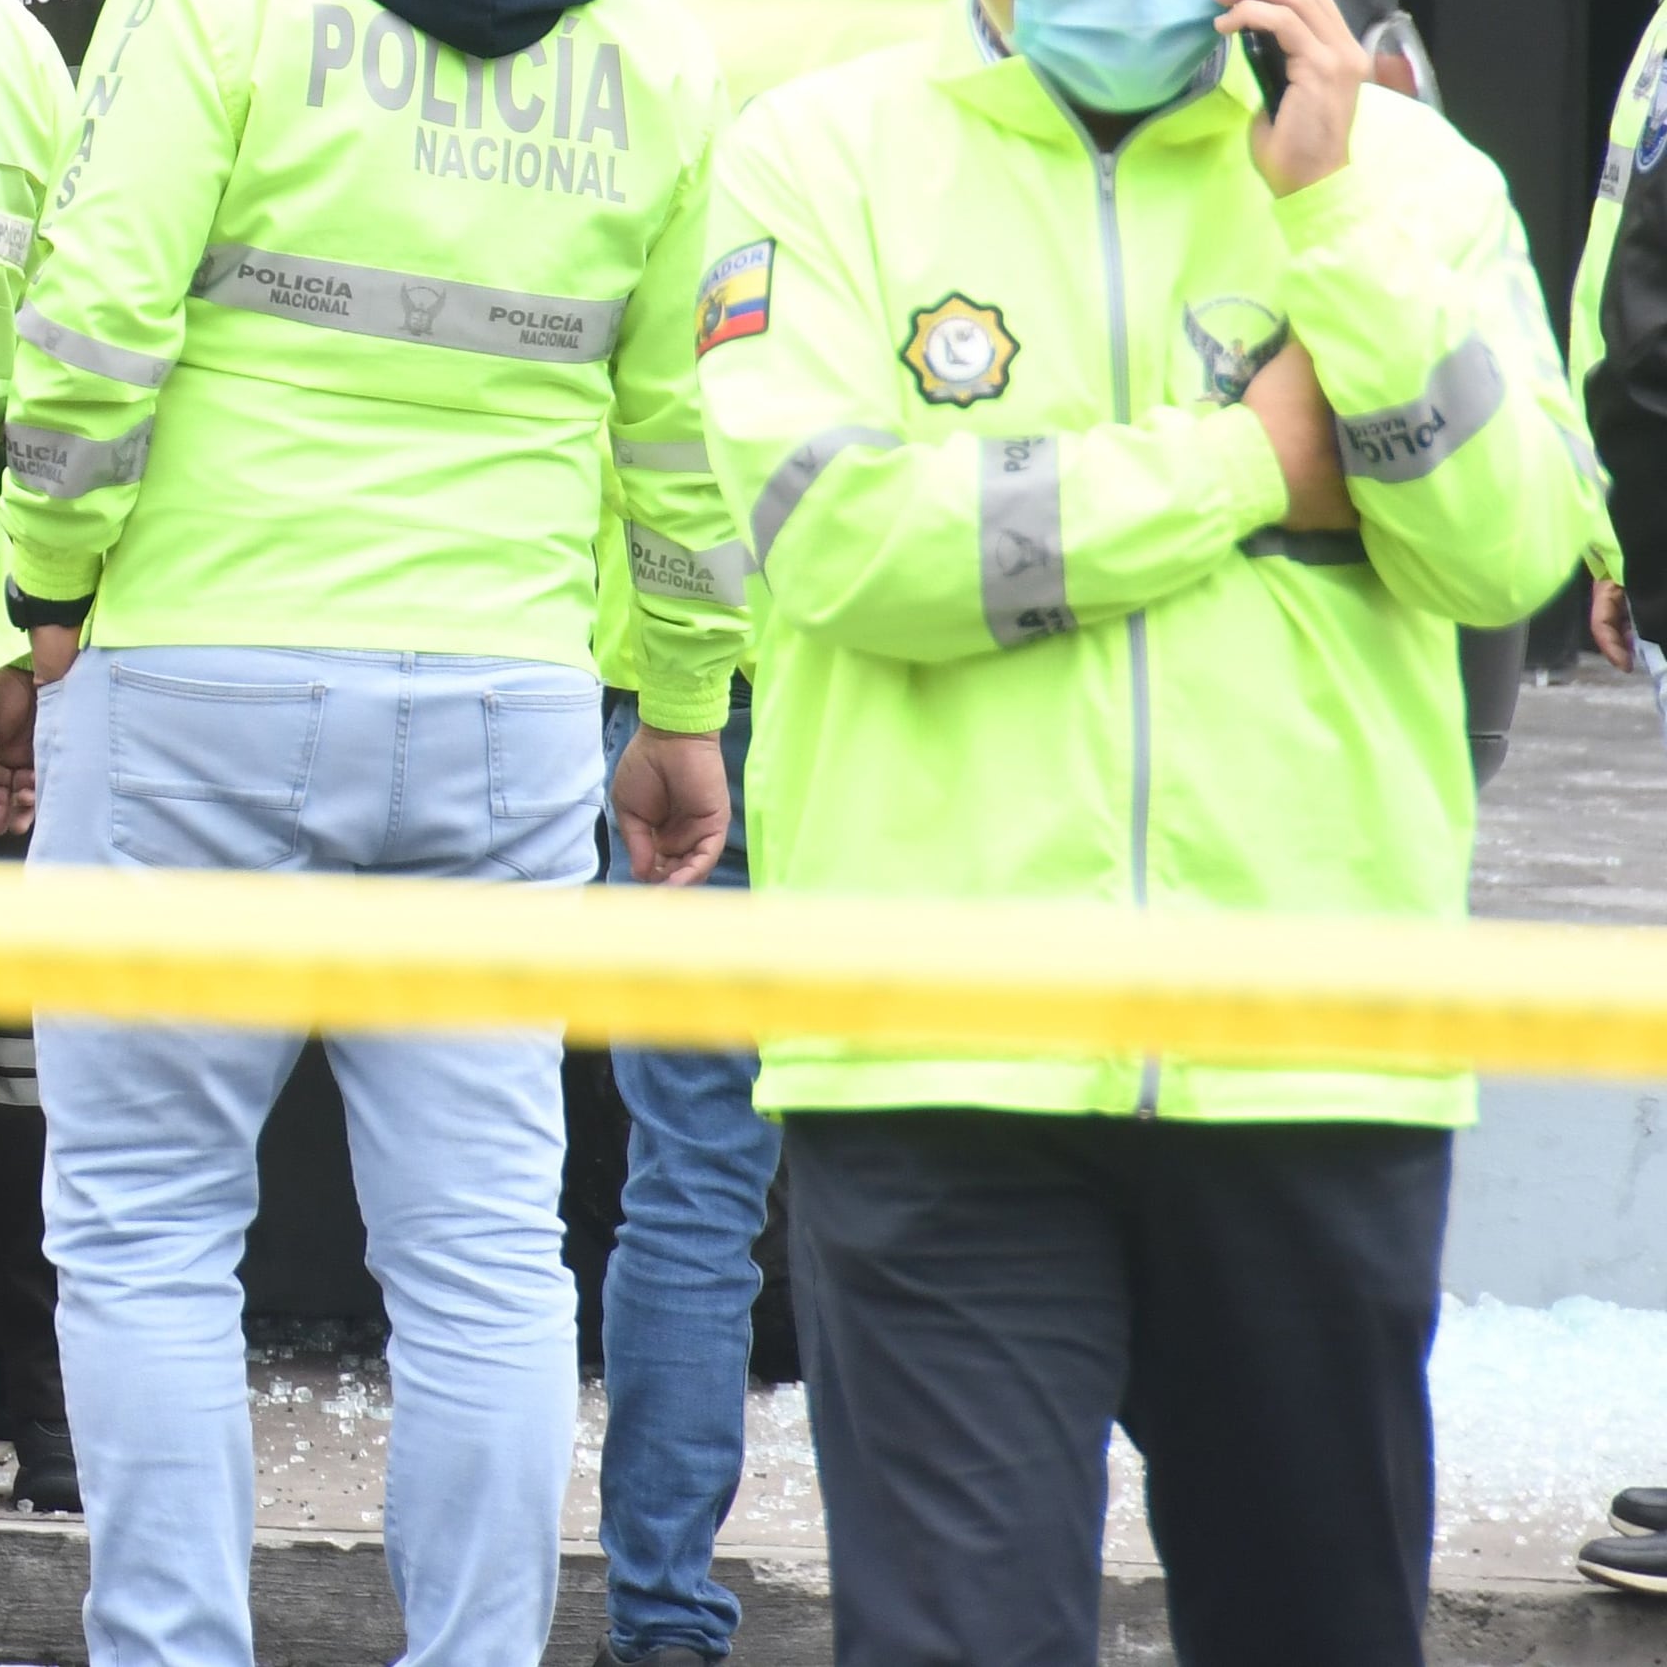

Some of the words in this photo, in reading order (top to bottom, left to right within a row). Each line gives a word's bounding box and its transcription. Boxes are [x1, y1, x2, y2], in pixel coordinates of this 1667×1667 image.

[306, 3, 629, 151] POLICÍA
[414, 126, 626, 203] NACIONAL
[237, 264, 353, 299] POLICÍA
[269, 288, 350, 316] NACIONAL
[489, 306, 583, 333] POLICÍA
[519, 331, 579, 349] NACIONAL
[637, 565, 714, 595] NACIONAL
